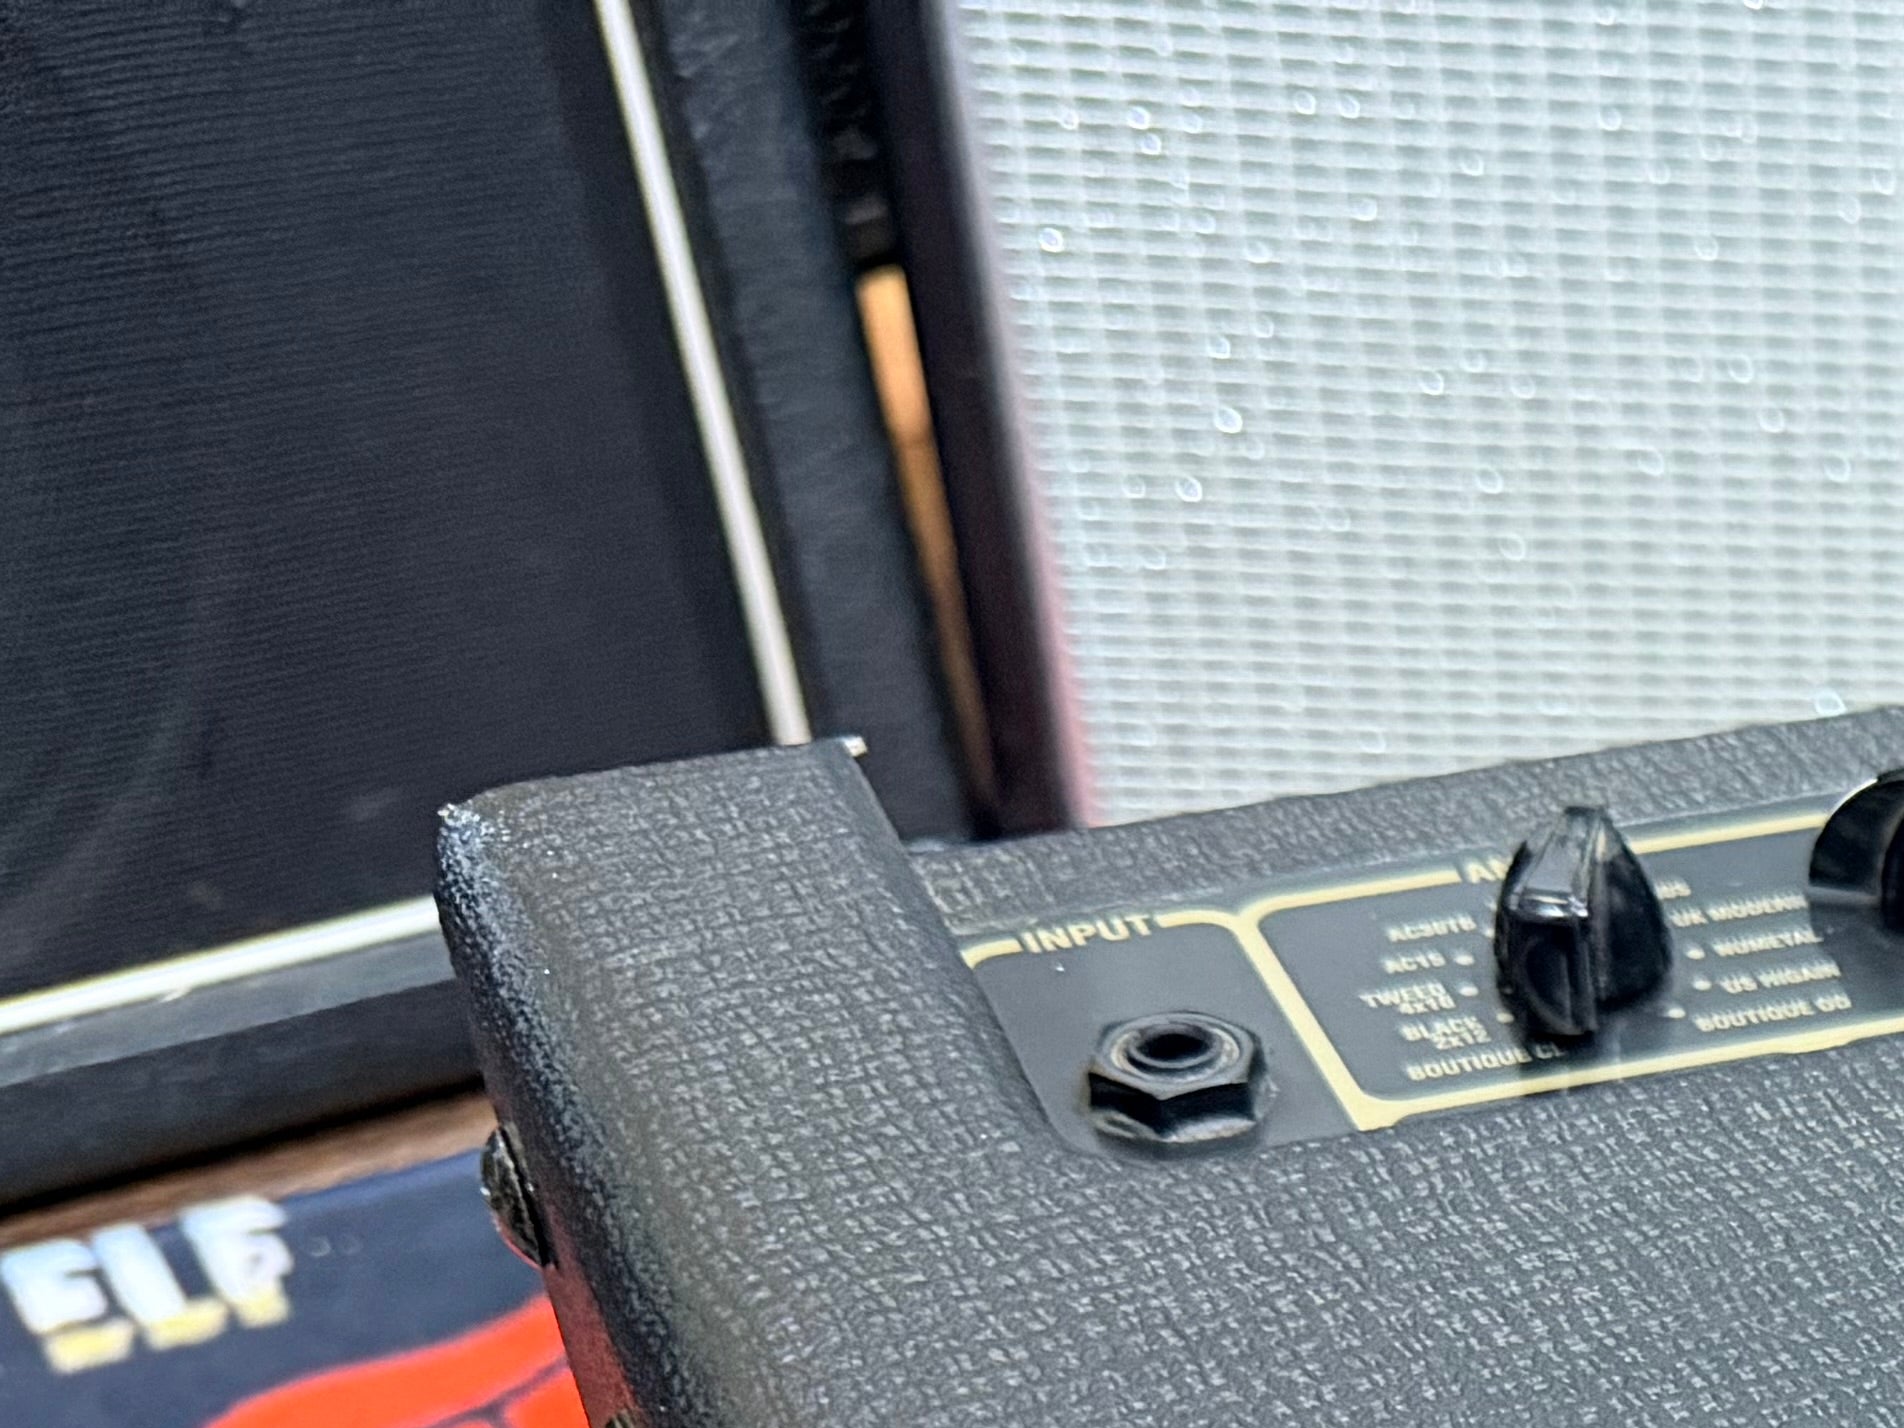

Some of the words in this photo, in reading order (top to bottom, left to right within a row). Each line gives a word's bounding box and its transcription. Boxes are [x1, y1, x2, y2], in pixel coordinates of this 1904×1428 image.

[1020, 914, 1152, 954] INPUT
[1711, 928, 1825, 957] NUMETAL
[1382, 951, 1447, 974] AC15
[1359, 982, 1448, 1008] TWEED
[1719, 974, 1758, 994] US
[1694, 1000, 1817, 1033] BOUTIQUE
[1812, 992, 1852, 1013] OD
[1400, 1016, 1484, 1042] BLACK
[1405, 1045, 1534, 1081] BOUTIQUE
